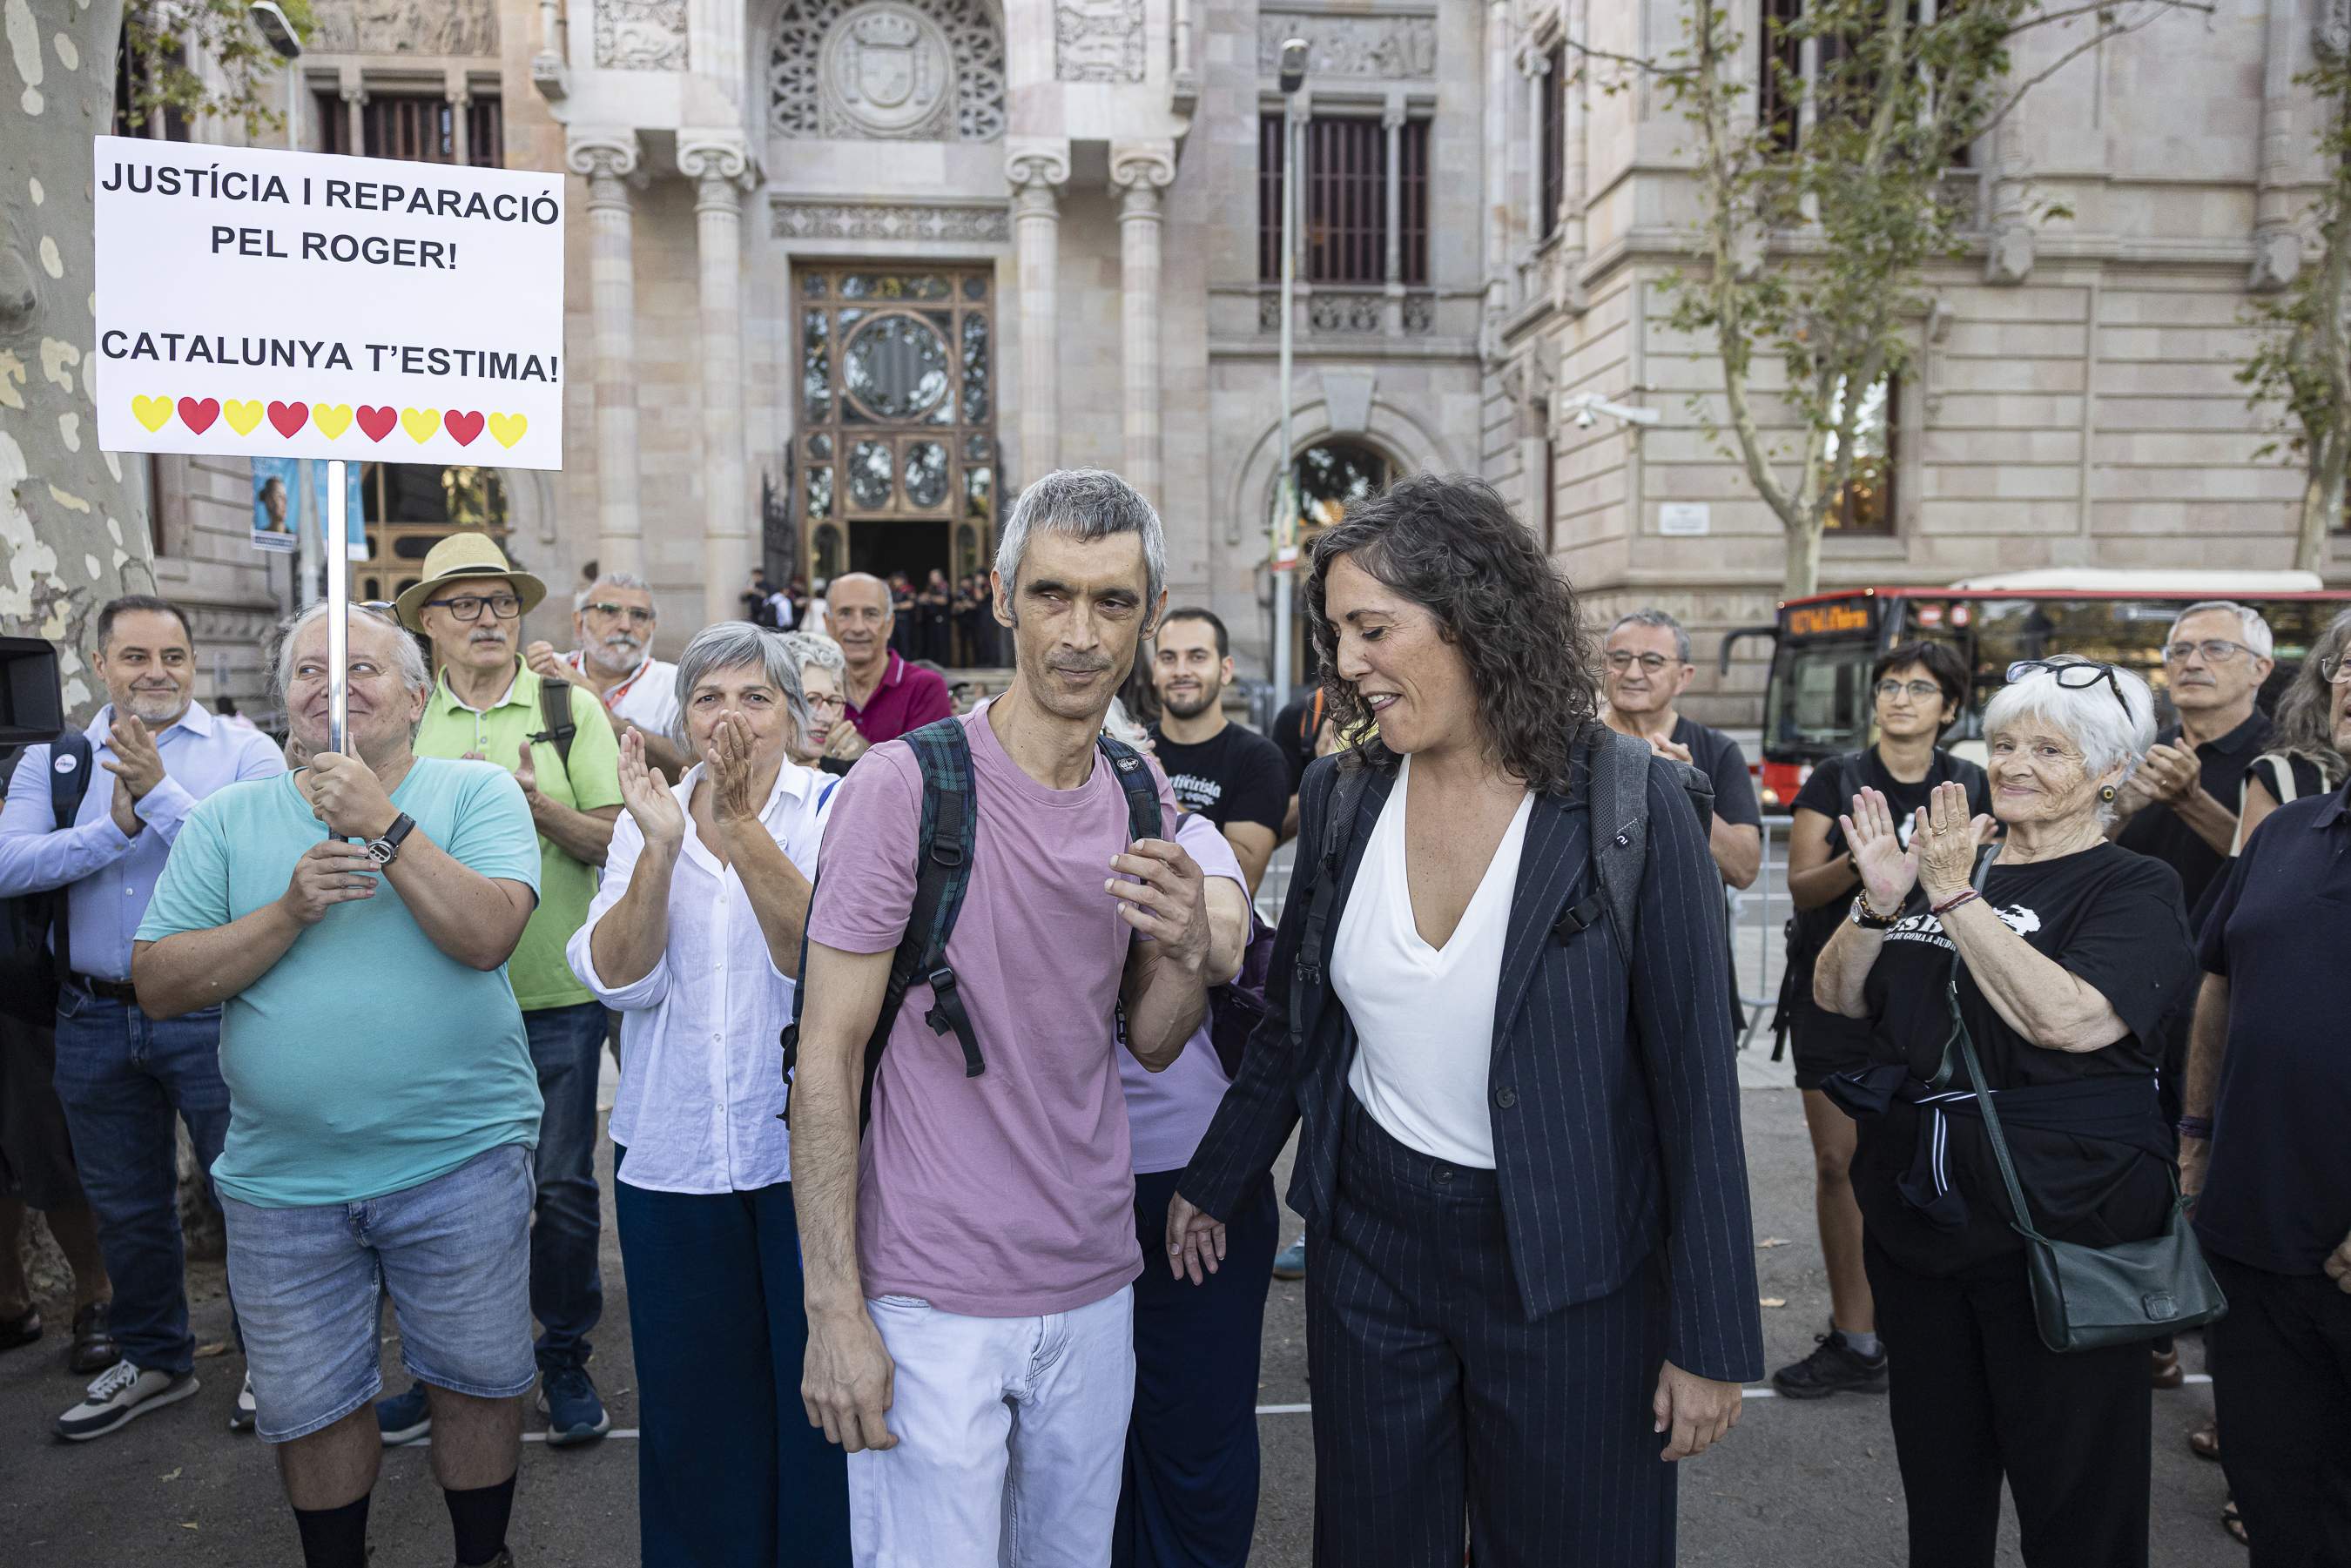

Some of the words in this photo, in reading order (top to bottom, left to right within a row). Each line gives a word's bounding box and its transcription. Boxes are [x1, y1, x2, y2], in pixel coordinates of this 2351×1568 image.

[101, 162, 290, 205] JUSTÍCIA
[303, 178, 311, 205] I
[326, 179, 559, 225] REPARACIÓ
[212, 225, 288, 259] PEL
[302, 232, 456, 270] ROGER!
[101, 330, 354, 371] CATALUNYA
[365, 344, 558, 383] T’ESTIMA!
[1903, 932, 1924, 942] GOMA
